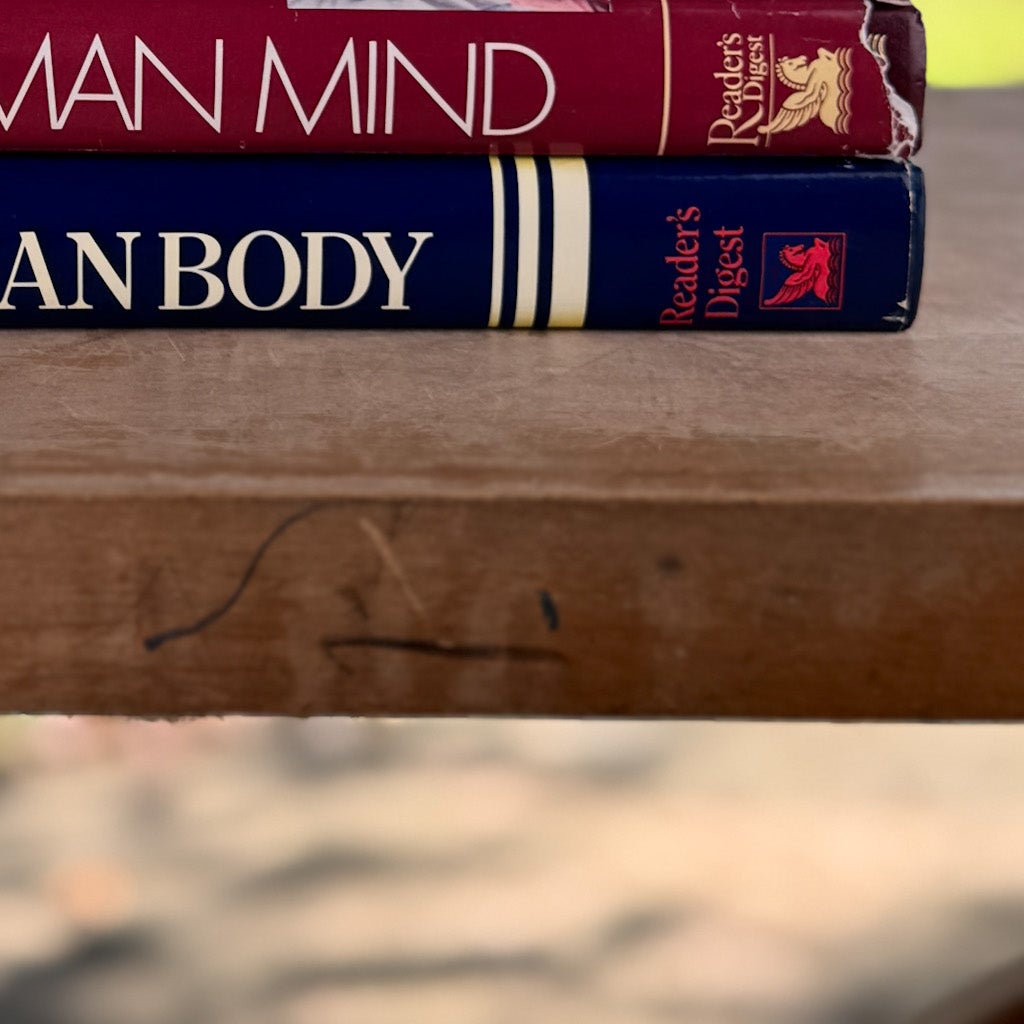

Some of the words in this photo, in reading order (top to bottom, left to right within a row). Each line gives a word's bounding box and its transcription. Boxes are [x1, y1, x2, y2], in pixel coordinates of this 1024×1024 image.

[254, 35, 557, 138] MIND
[707, 32, 763, 147] Reader's
[744, 34, 768, 101] Digest
[157, 228, 435, 313] BODY
[660, 206, 701, 326] Reader's
[705, 225, 749, 319] Digest
